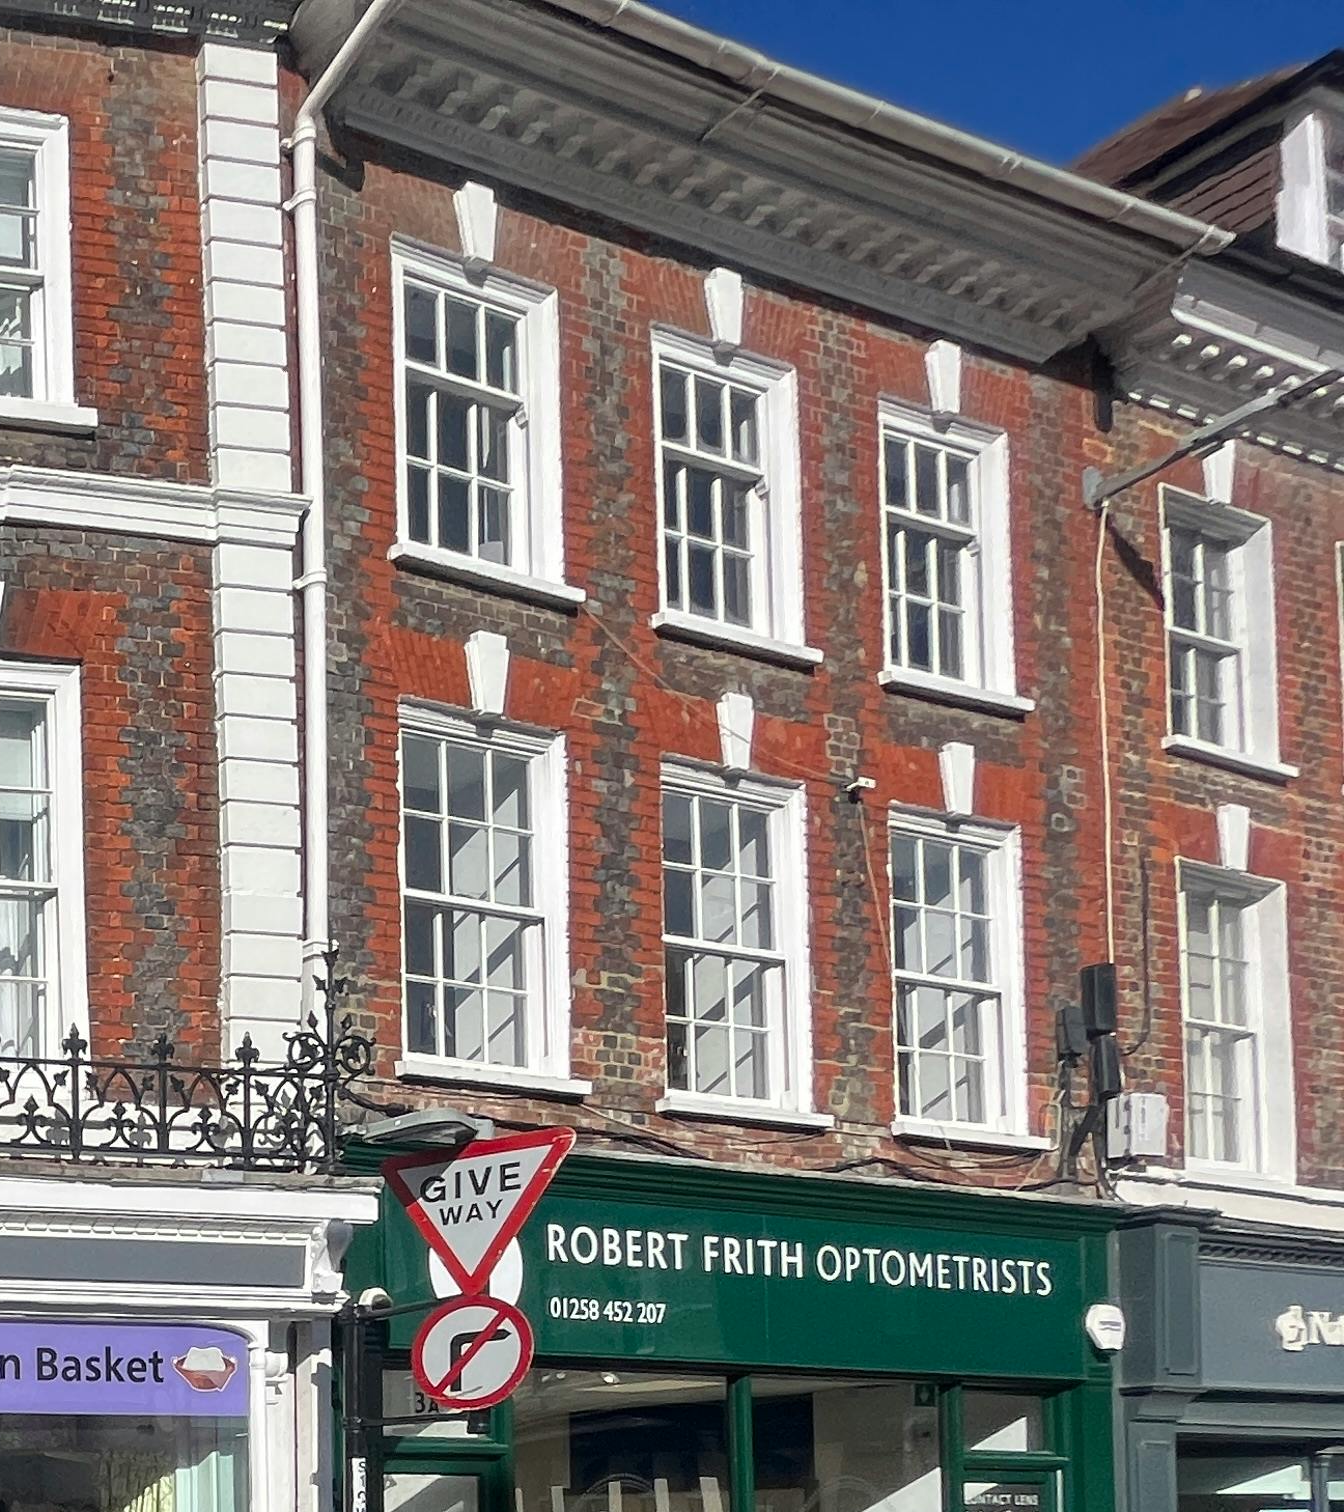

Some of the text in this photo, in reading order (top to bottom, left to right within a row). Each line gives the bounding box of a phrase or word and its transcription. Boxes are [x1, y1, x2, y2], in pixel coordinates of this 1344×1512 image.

[420, 1161, 521, 1203] GIVE
[439, 1199, 504, 1226] WAY
[547, 1223, 1052, 1296] ROBERT FRITH OPTOMETRISTS
[550, 1297, 666, 1324] 01258 452 207
[36, 1346, 164, 1384] Basket
[1014, 1494, 1038, 1505] LENS
